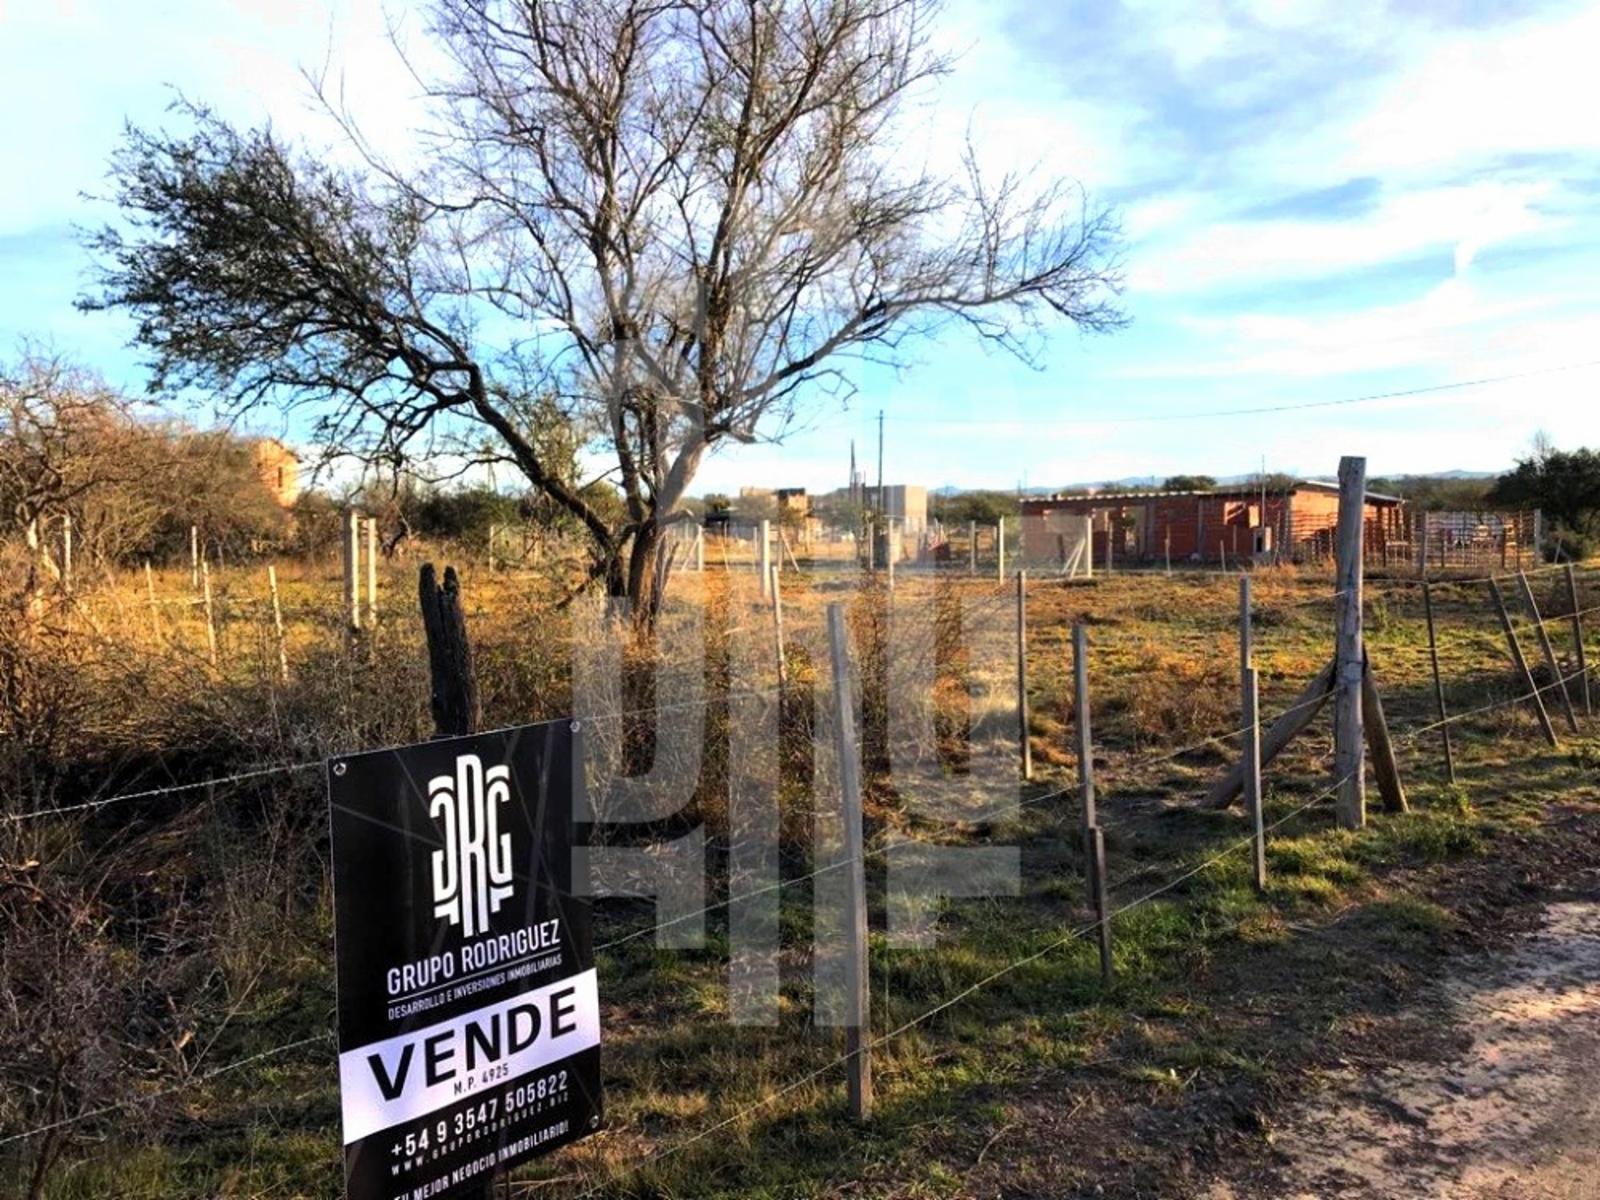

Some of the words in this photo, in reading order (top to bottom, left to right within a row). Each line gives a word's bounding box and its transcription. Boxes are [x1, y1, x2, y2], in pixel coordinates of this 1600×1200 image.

[386, 951, 455, 995] GRUPO
[461, 918, 562, 973] RODRIGUEZ
[387, 993, 446, 1021] DESARROLLO
[447, 990, 453, 1002] E
[453, 972, 506, 999] INVERSIONES
[507, 954, 563, 982] INMOBILIARIAS
[366, 985, 578, 1102] VENDE
[482, 1063, 510, 1084] 4925
[391, 1128, 430, 1156] +54
[436, 1121, 448, 1143] 9
[454, 1098, 498, 1135] 3547
[505, 1070, 568, 1113] 505822
[413, 1175, 449, 1200] MEJOR
[452, 1152, 496, 1185] NEGOCIO
[498, 1119, 569, 1161] INMOBILIARIO!
